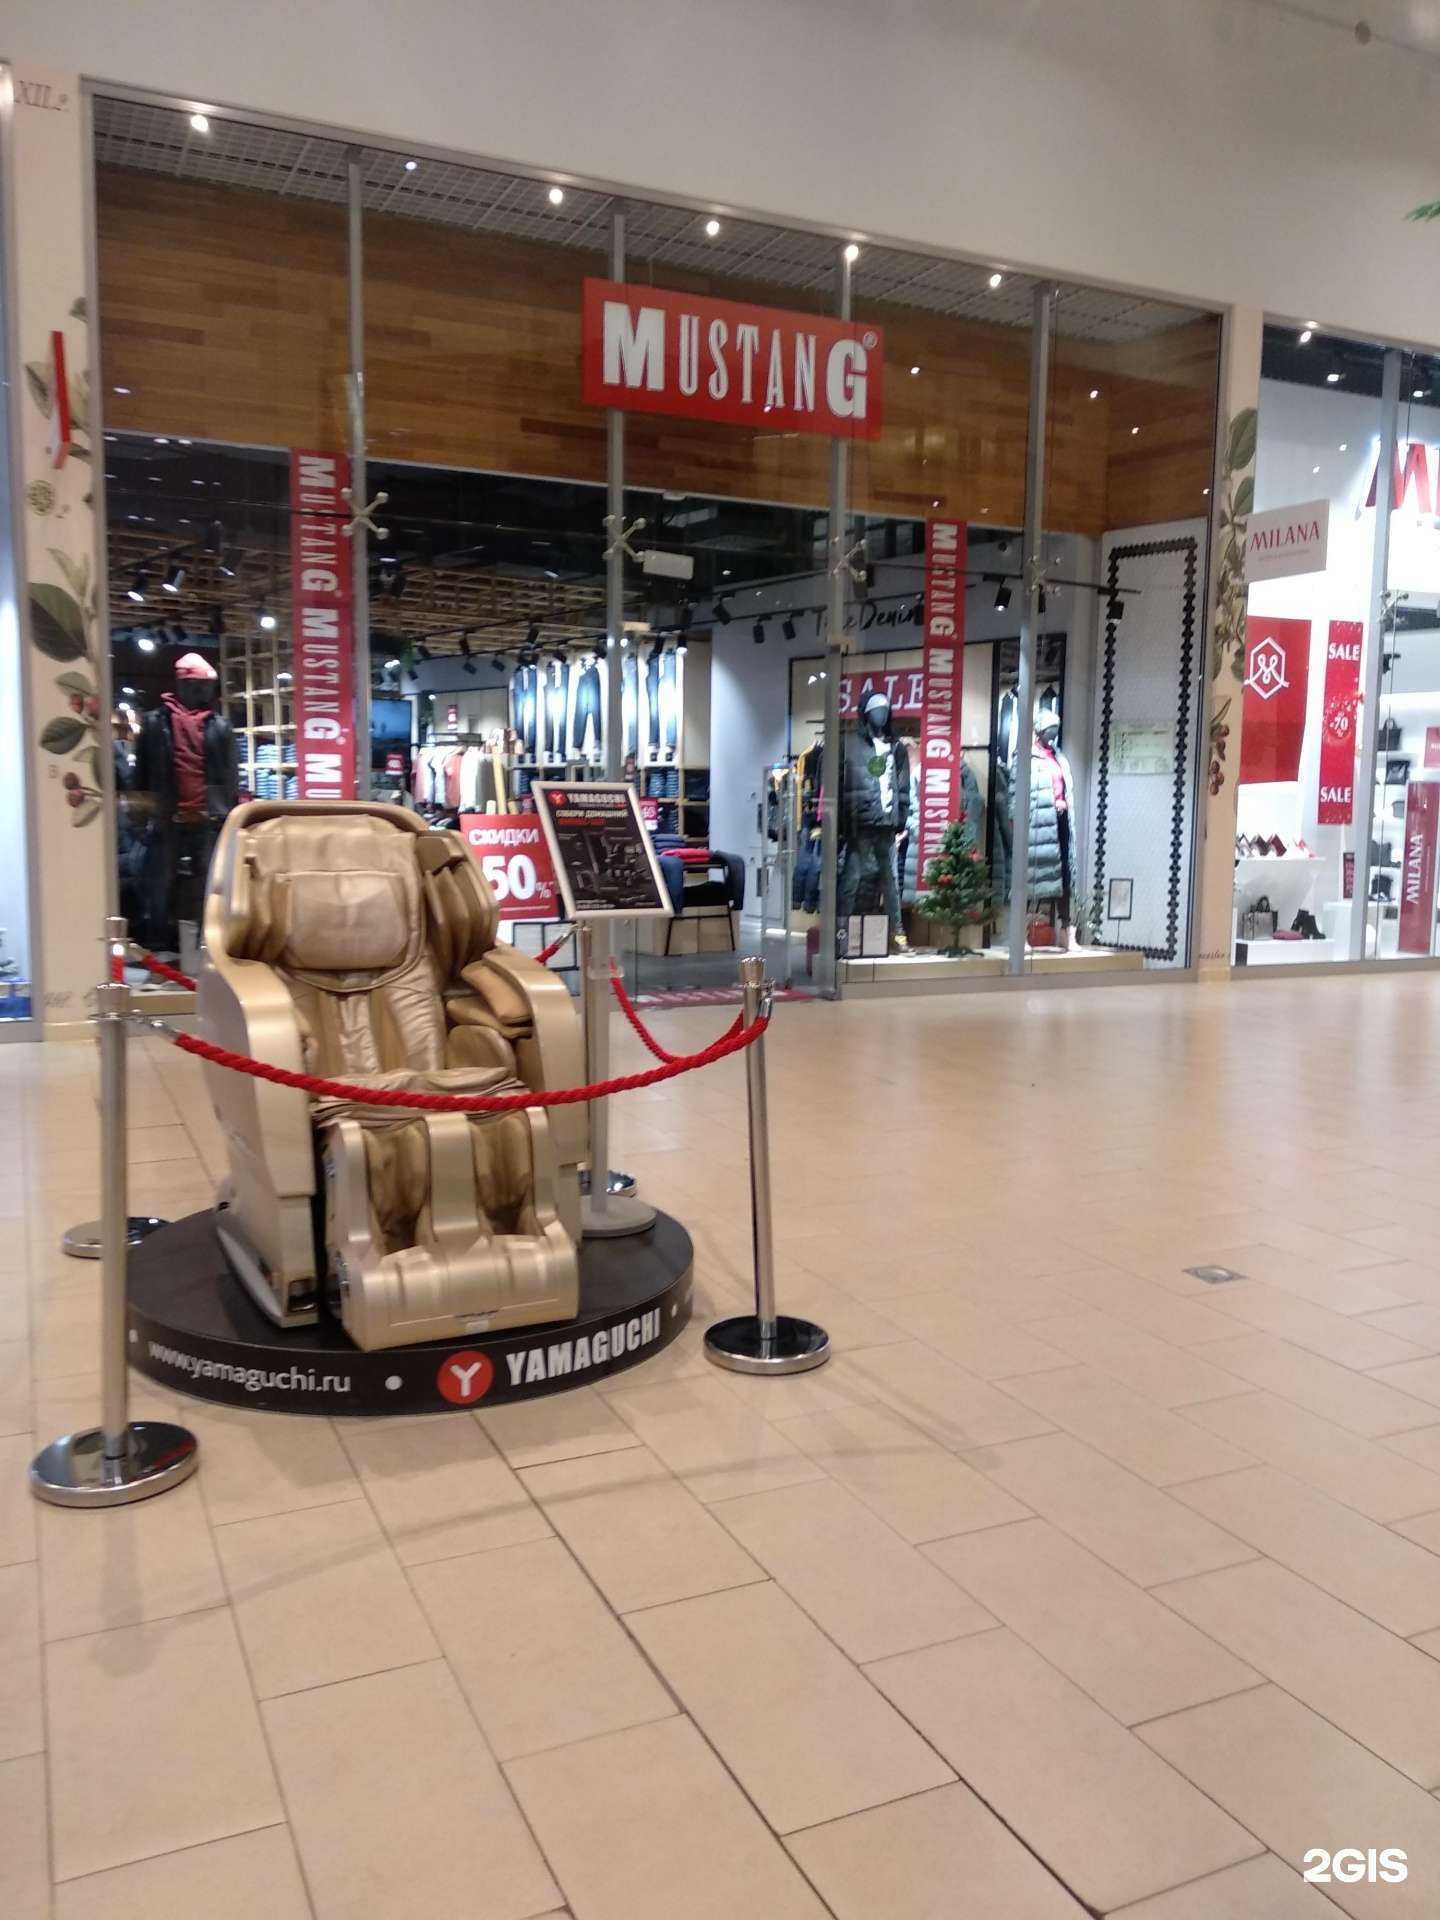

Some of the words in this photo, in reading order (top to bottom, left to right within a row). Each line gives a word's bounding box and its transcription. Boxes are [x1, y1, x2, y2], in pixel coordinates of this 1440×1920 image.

[603, 300, 868, 419] MUSTANG
[1250, 520, 1322, 550] MILANA
[301, 607, 340, 740] MUSTANG
[1328, 642, 1360, 660] SALE
[926, 648, 953, 759] MUSTANG
[1320, 786, 1352, 803] SALE
[468, 828, 539, 847] СКИДКИ
[1406, 833, 1424, 905] MILANA
[149, 1341, 351, 1392] www.yamaguchi.ru
[506, 1307, 661, 1386] YAMAGUCHI
